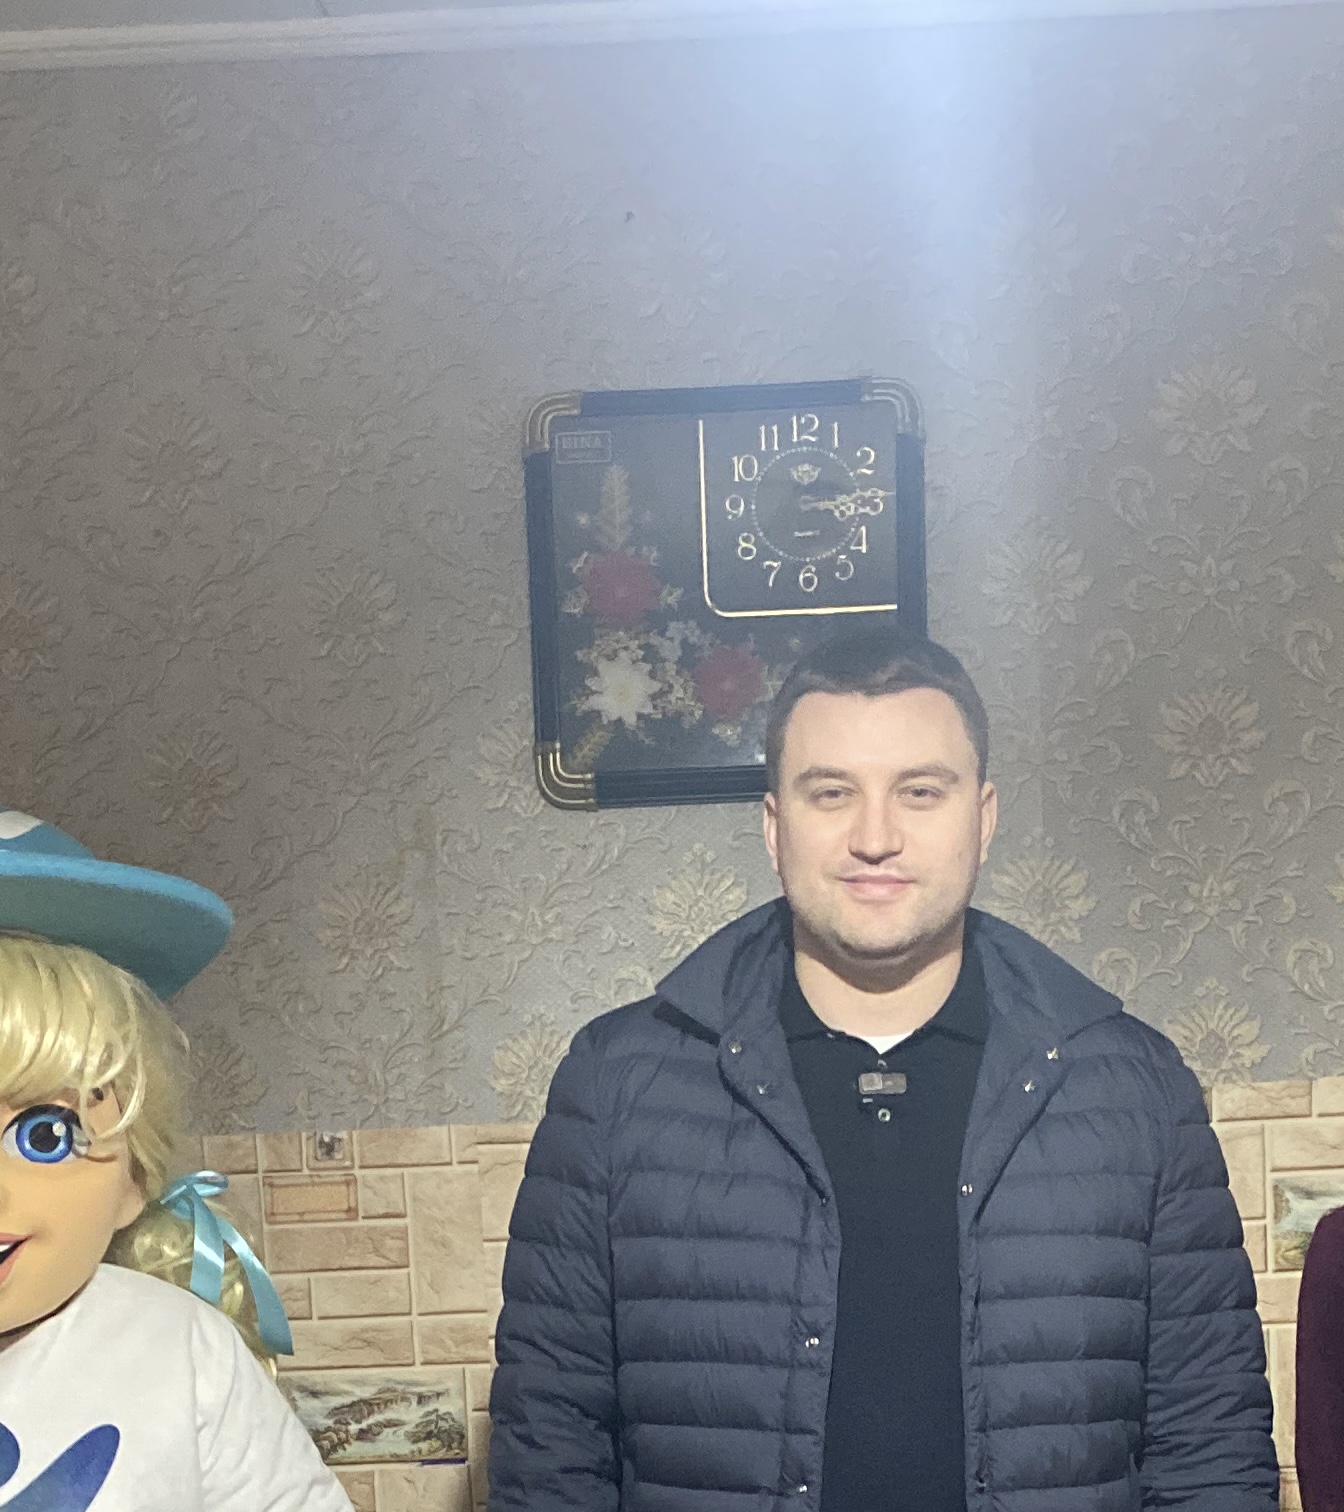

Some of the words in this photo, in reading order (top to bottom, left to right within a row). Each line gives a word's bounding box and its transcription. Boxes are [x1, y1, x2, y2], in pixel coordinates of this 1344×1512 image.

[759, 424, 779, 451] 11
[791, 413, 819, 443] 12
[833, 421, 839, 449] 1
[731, 454, 758, 482] 10
[856, 446, 875, 475] 2
[725, 494, 745, 521] 9
[737, 532, 757, 560] 8
[850, 525, 868, 554] 4
[763, 561, 782, 587] 7
[798, 565, 818, 592] 6
[834, 554, 854, 581] 5
